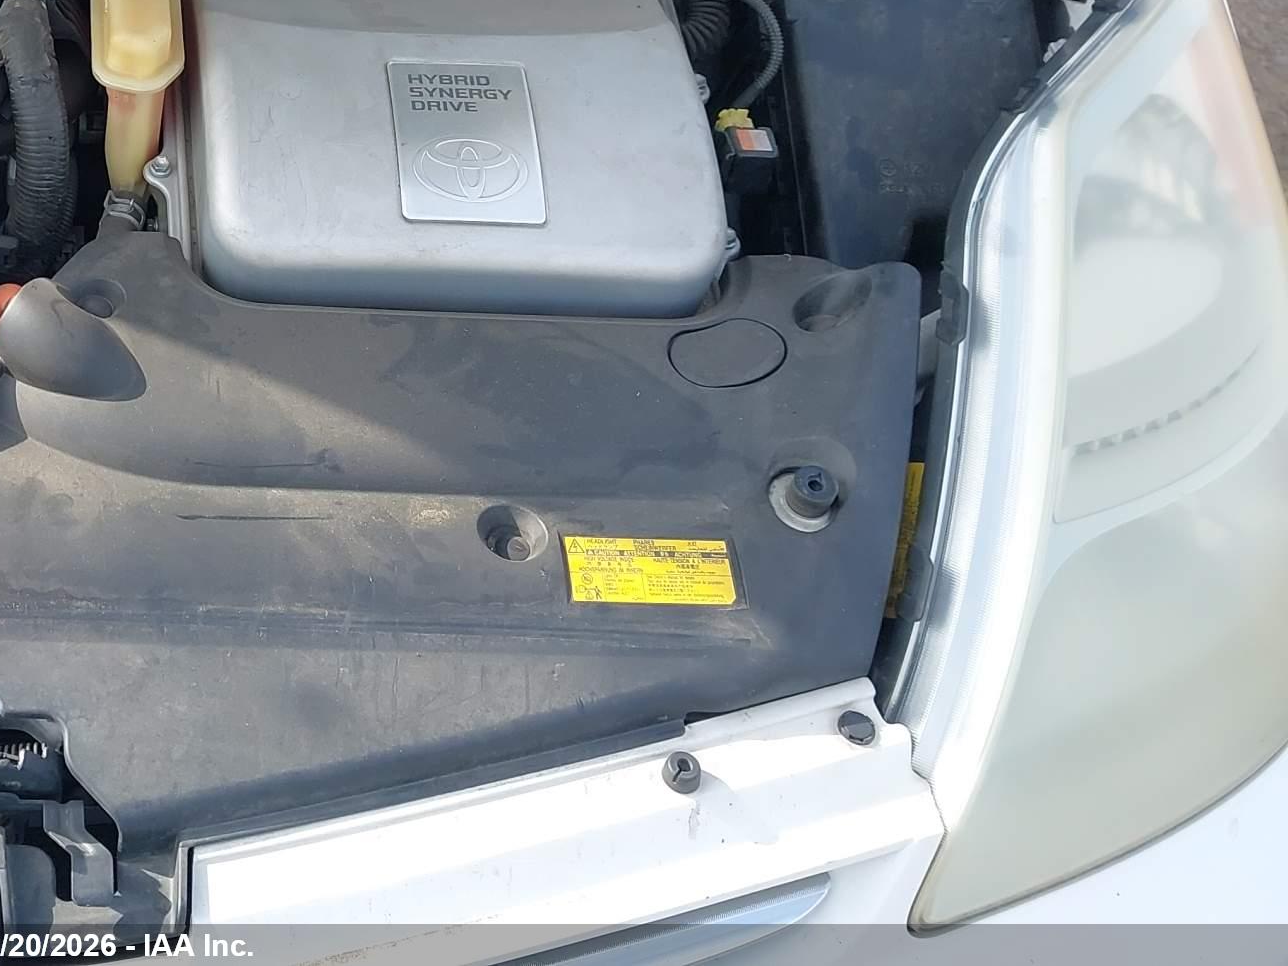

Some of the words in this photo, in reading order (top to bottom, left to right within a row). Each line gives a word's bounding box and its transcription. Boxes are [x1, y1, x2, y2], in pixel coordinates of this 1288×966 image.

[408, 74, 490, 86] HYBRID
[409, 87, 512, 101] SYNERGY
[411, 100, 479, 112] DRIVE
